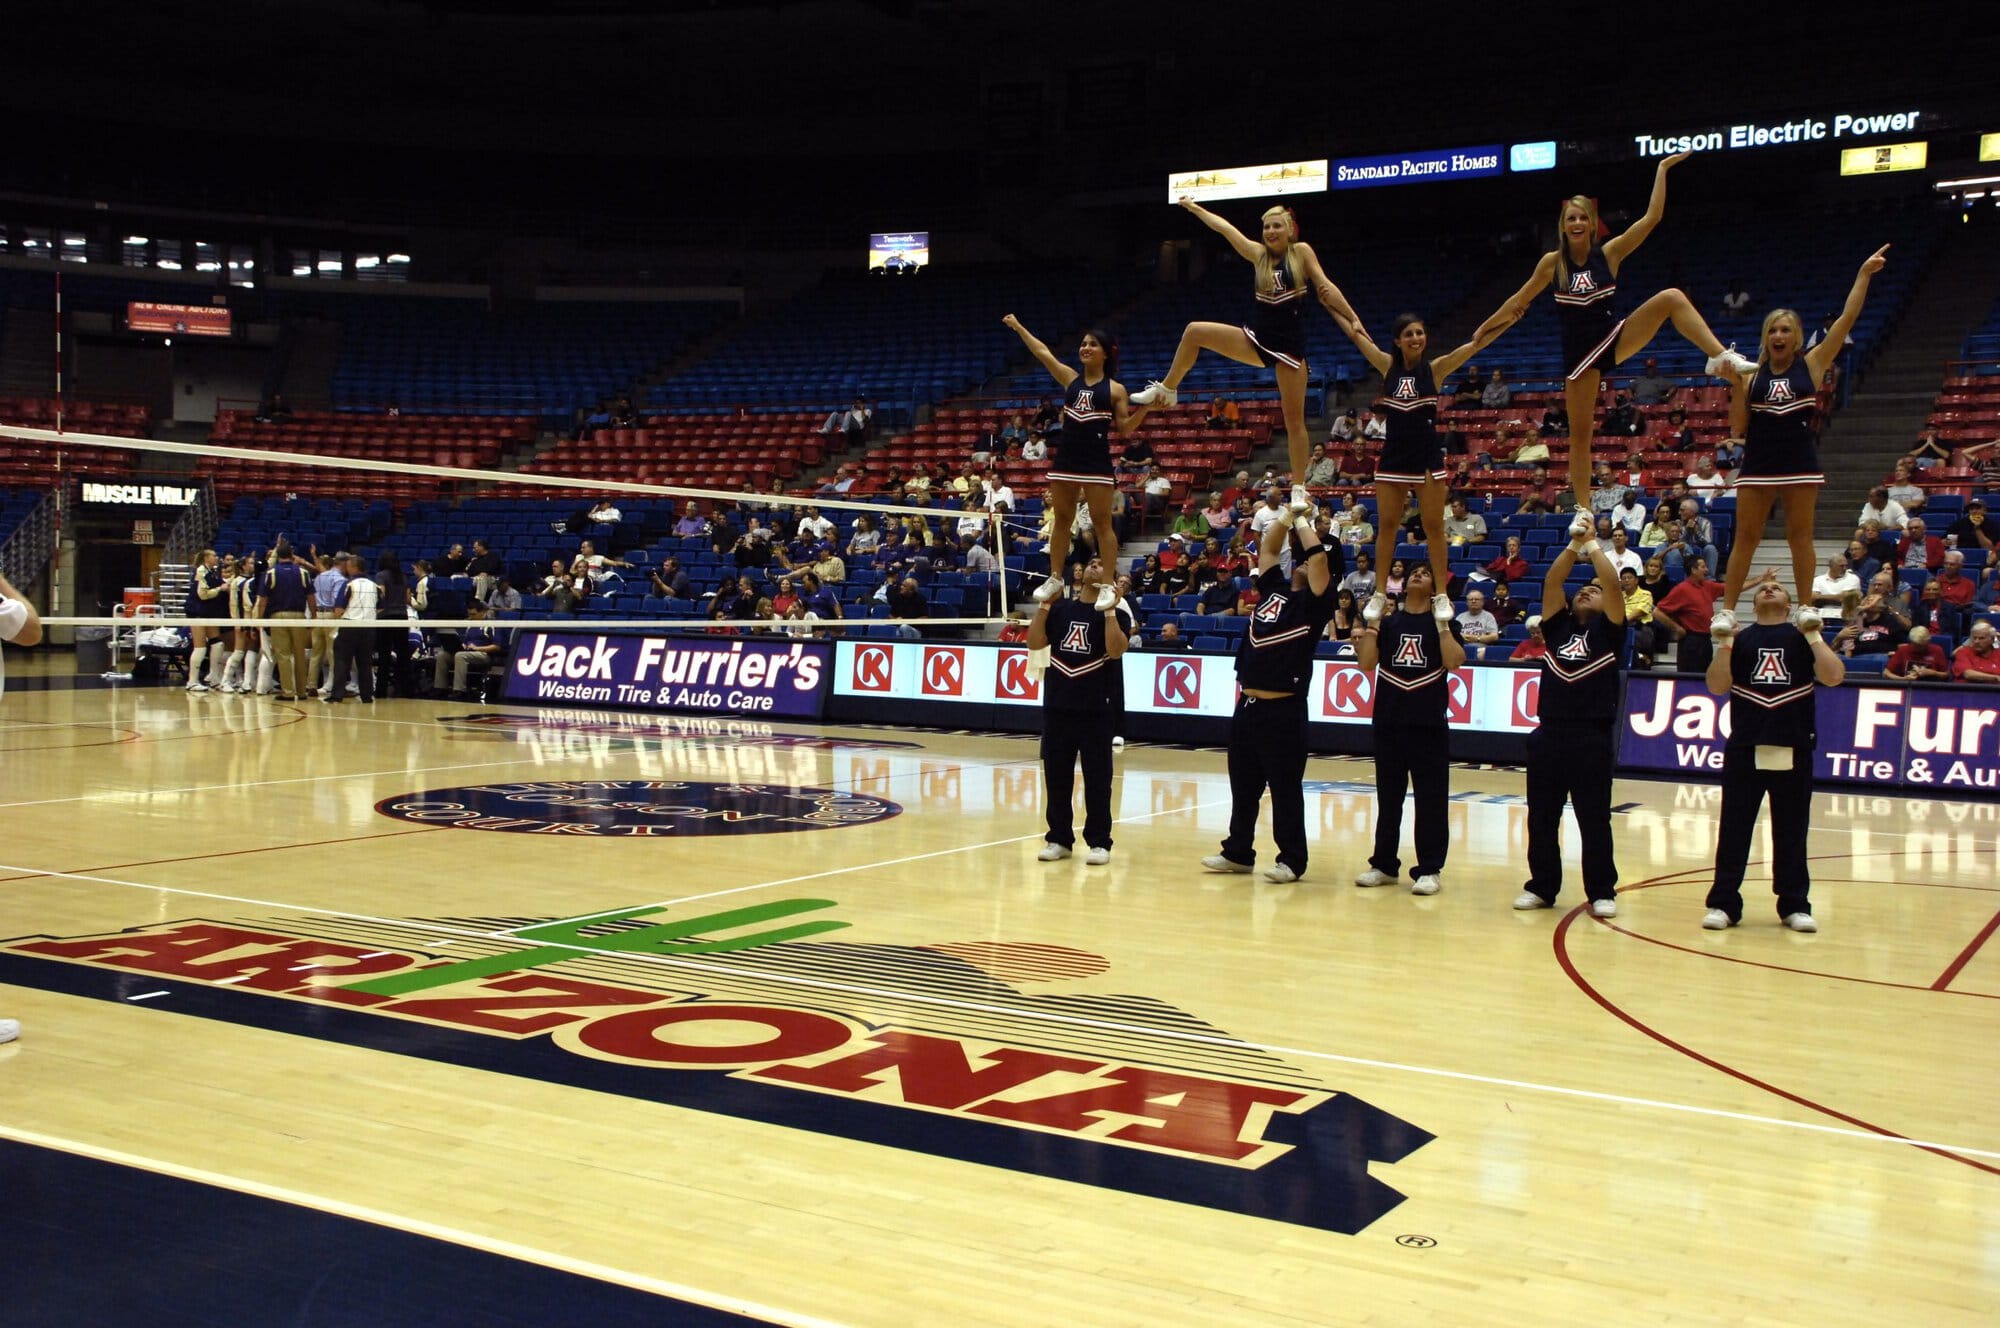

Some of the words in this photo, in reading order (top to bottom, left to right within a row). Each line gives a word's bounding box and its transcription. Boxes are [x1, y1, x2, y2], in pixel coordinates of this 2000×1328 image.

[1635, 132, 1723, 157] Tucson
[1730, 120, 1826, 148] Electric
[1834, 111, 1920, 138] Power
[1337, 164, 1399, 181] STANDARD
[1401, 159, 1447, 177] PACIFIC
[1451, 154, 1498, 172] HOMES
[1569, 269, 1598, 295] A
[134, 302, 154, 310] NEW
[1074, 389, 1094, 411] A
[1393, 375, 1419, 400] A
[1600, 380, 1607, 392] 3
[1765, 377, 1797, 403] A
[82, 483, 152, 504] MUSCLE
[153, 485, 198, 506] MILK
[1485, 492, 1493, 504] 3
[1254, 592, 1289, 624] A
[1060, 621, 1092, 655] A
[1391, 633, 1428, 669] A
[516, 634, 618, 680] Jack
[633, 636, 822, 690] Furrier's
[1751, 648, 1791, 686] A
[538, 680, 611, 702] Western
[617, 684, 652, 704] Tire
[656, 687, 671, 705] &
[674, 687, 722, 709] Auto
[727, 690, 774, 711] Care
[1629, 679, 1731, 741] Ja
[1852, 688, 2000, 755] Fur
[1826, 751, 1894, 780] Tire
[1905, 757, 1934, 784] &
[1943, 760, 2000, 788] Au
[391, 802, 675, 836] COURT
[506, 793, 782, 822] OLSON
